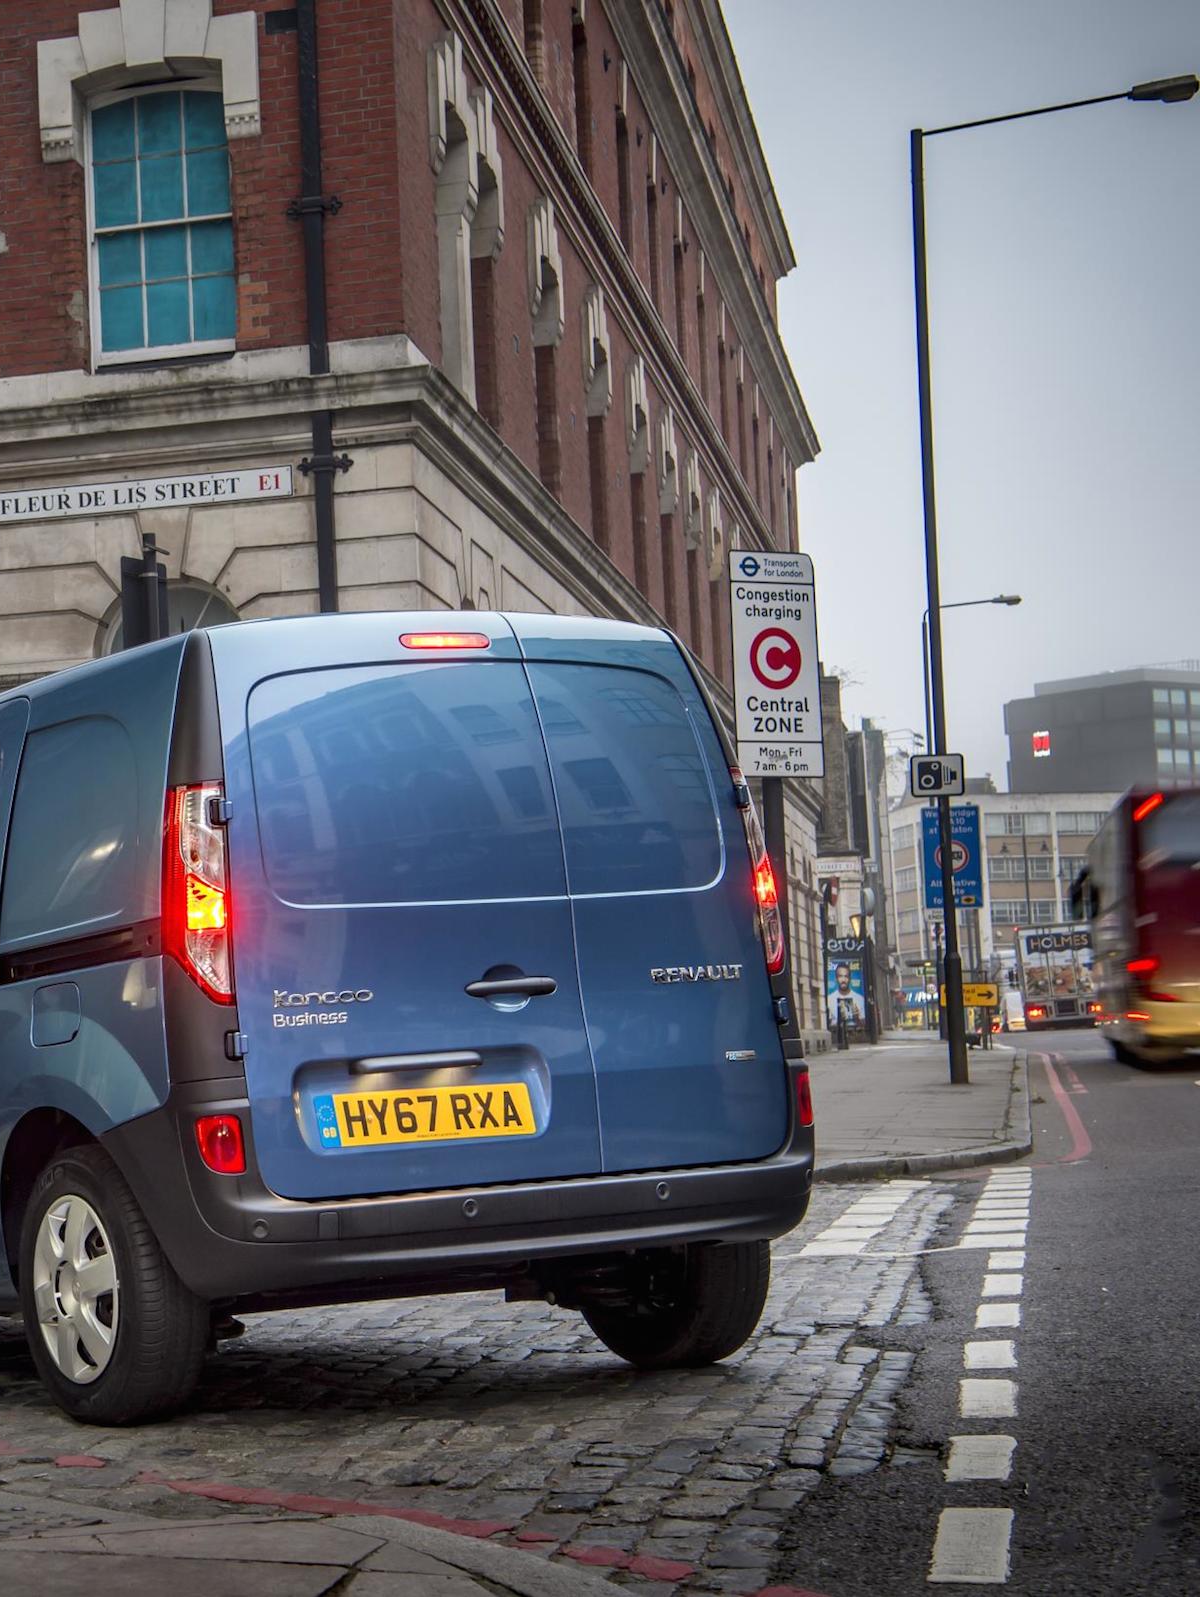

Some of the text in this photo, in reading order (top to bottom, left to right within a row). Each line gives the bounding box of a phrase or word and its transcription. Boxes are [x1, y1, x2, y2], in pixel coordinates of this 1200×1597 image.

[1, 473, 282, 515] FLEUR DE LIS STREET E1
[764, 558, 799, 569] Transport
[764, 568, 804, 578] for London
[736, 587, 809, 603] Congestion
[745, 604, 802, 620] charging
[746, 696, 810, 712] Central
[753, 717, 804, 733] ZONE
[759, 747, 781, 757] Mon
[789, 748, 802, 757] Fri
[1030, 933, 1089, 950] HOLMES
[651, 964, 743, 983] RENAULT
[272, 1011, 349, 1028] Business
[342, 1091, 524, 1138] HY67 RXA
